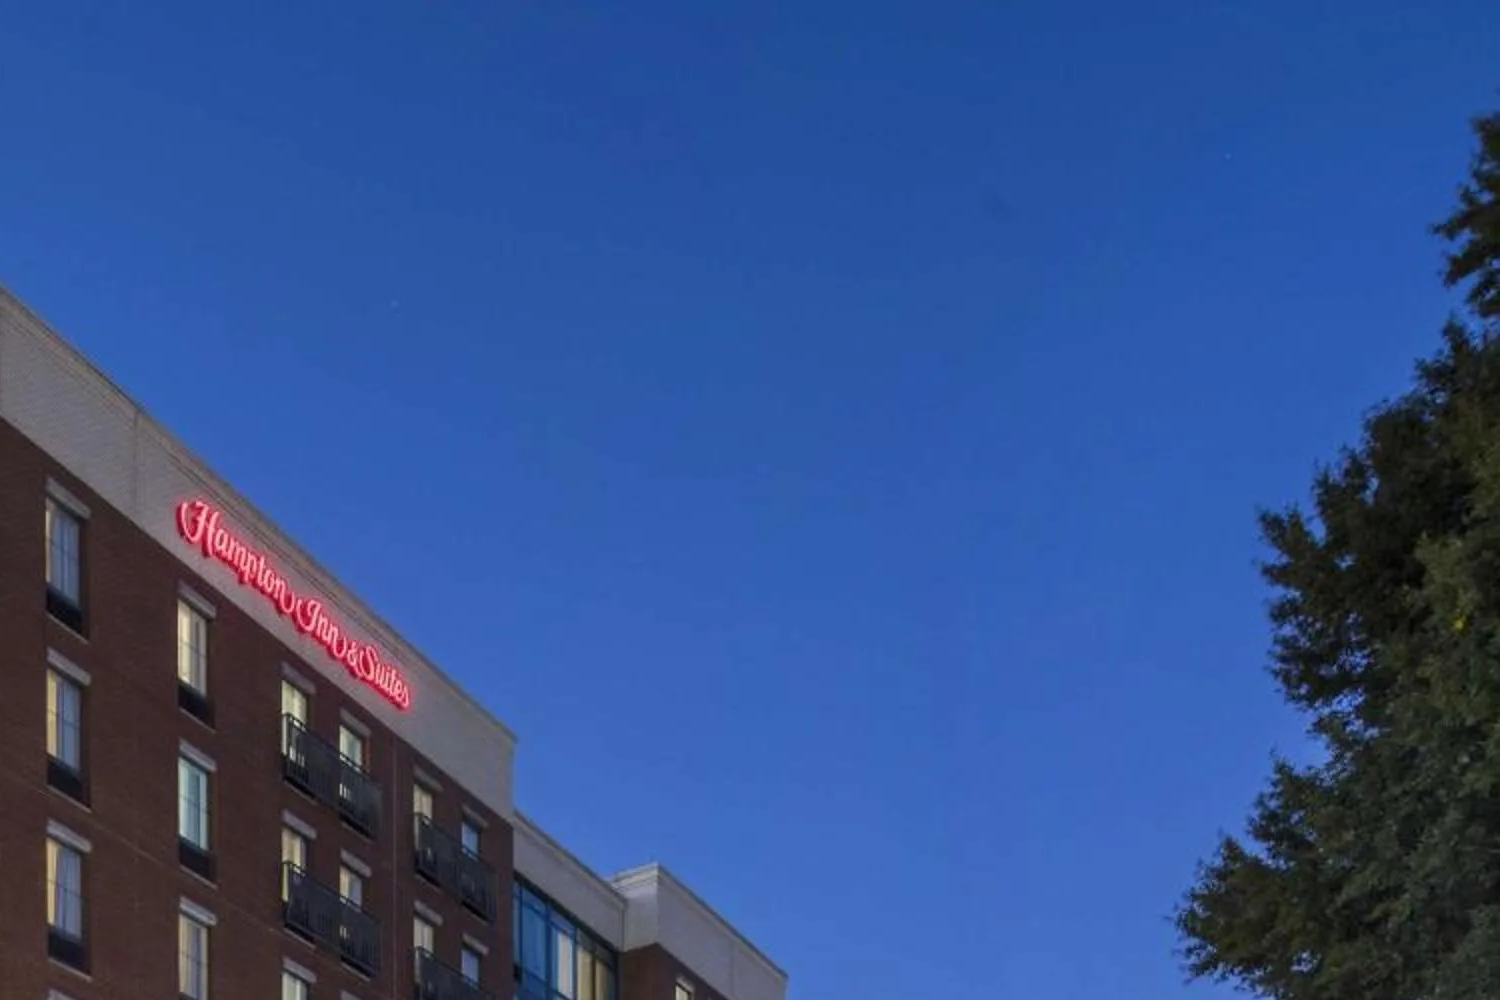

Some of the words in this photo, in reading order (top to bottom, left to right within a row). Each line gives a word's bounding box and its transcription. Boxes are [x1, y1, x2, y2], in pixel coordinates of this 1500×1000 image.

[177, 500, 296, 617] Hampton
[293, 599, 348, 660] Inn
[354, 646, 411, 711] Suites
